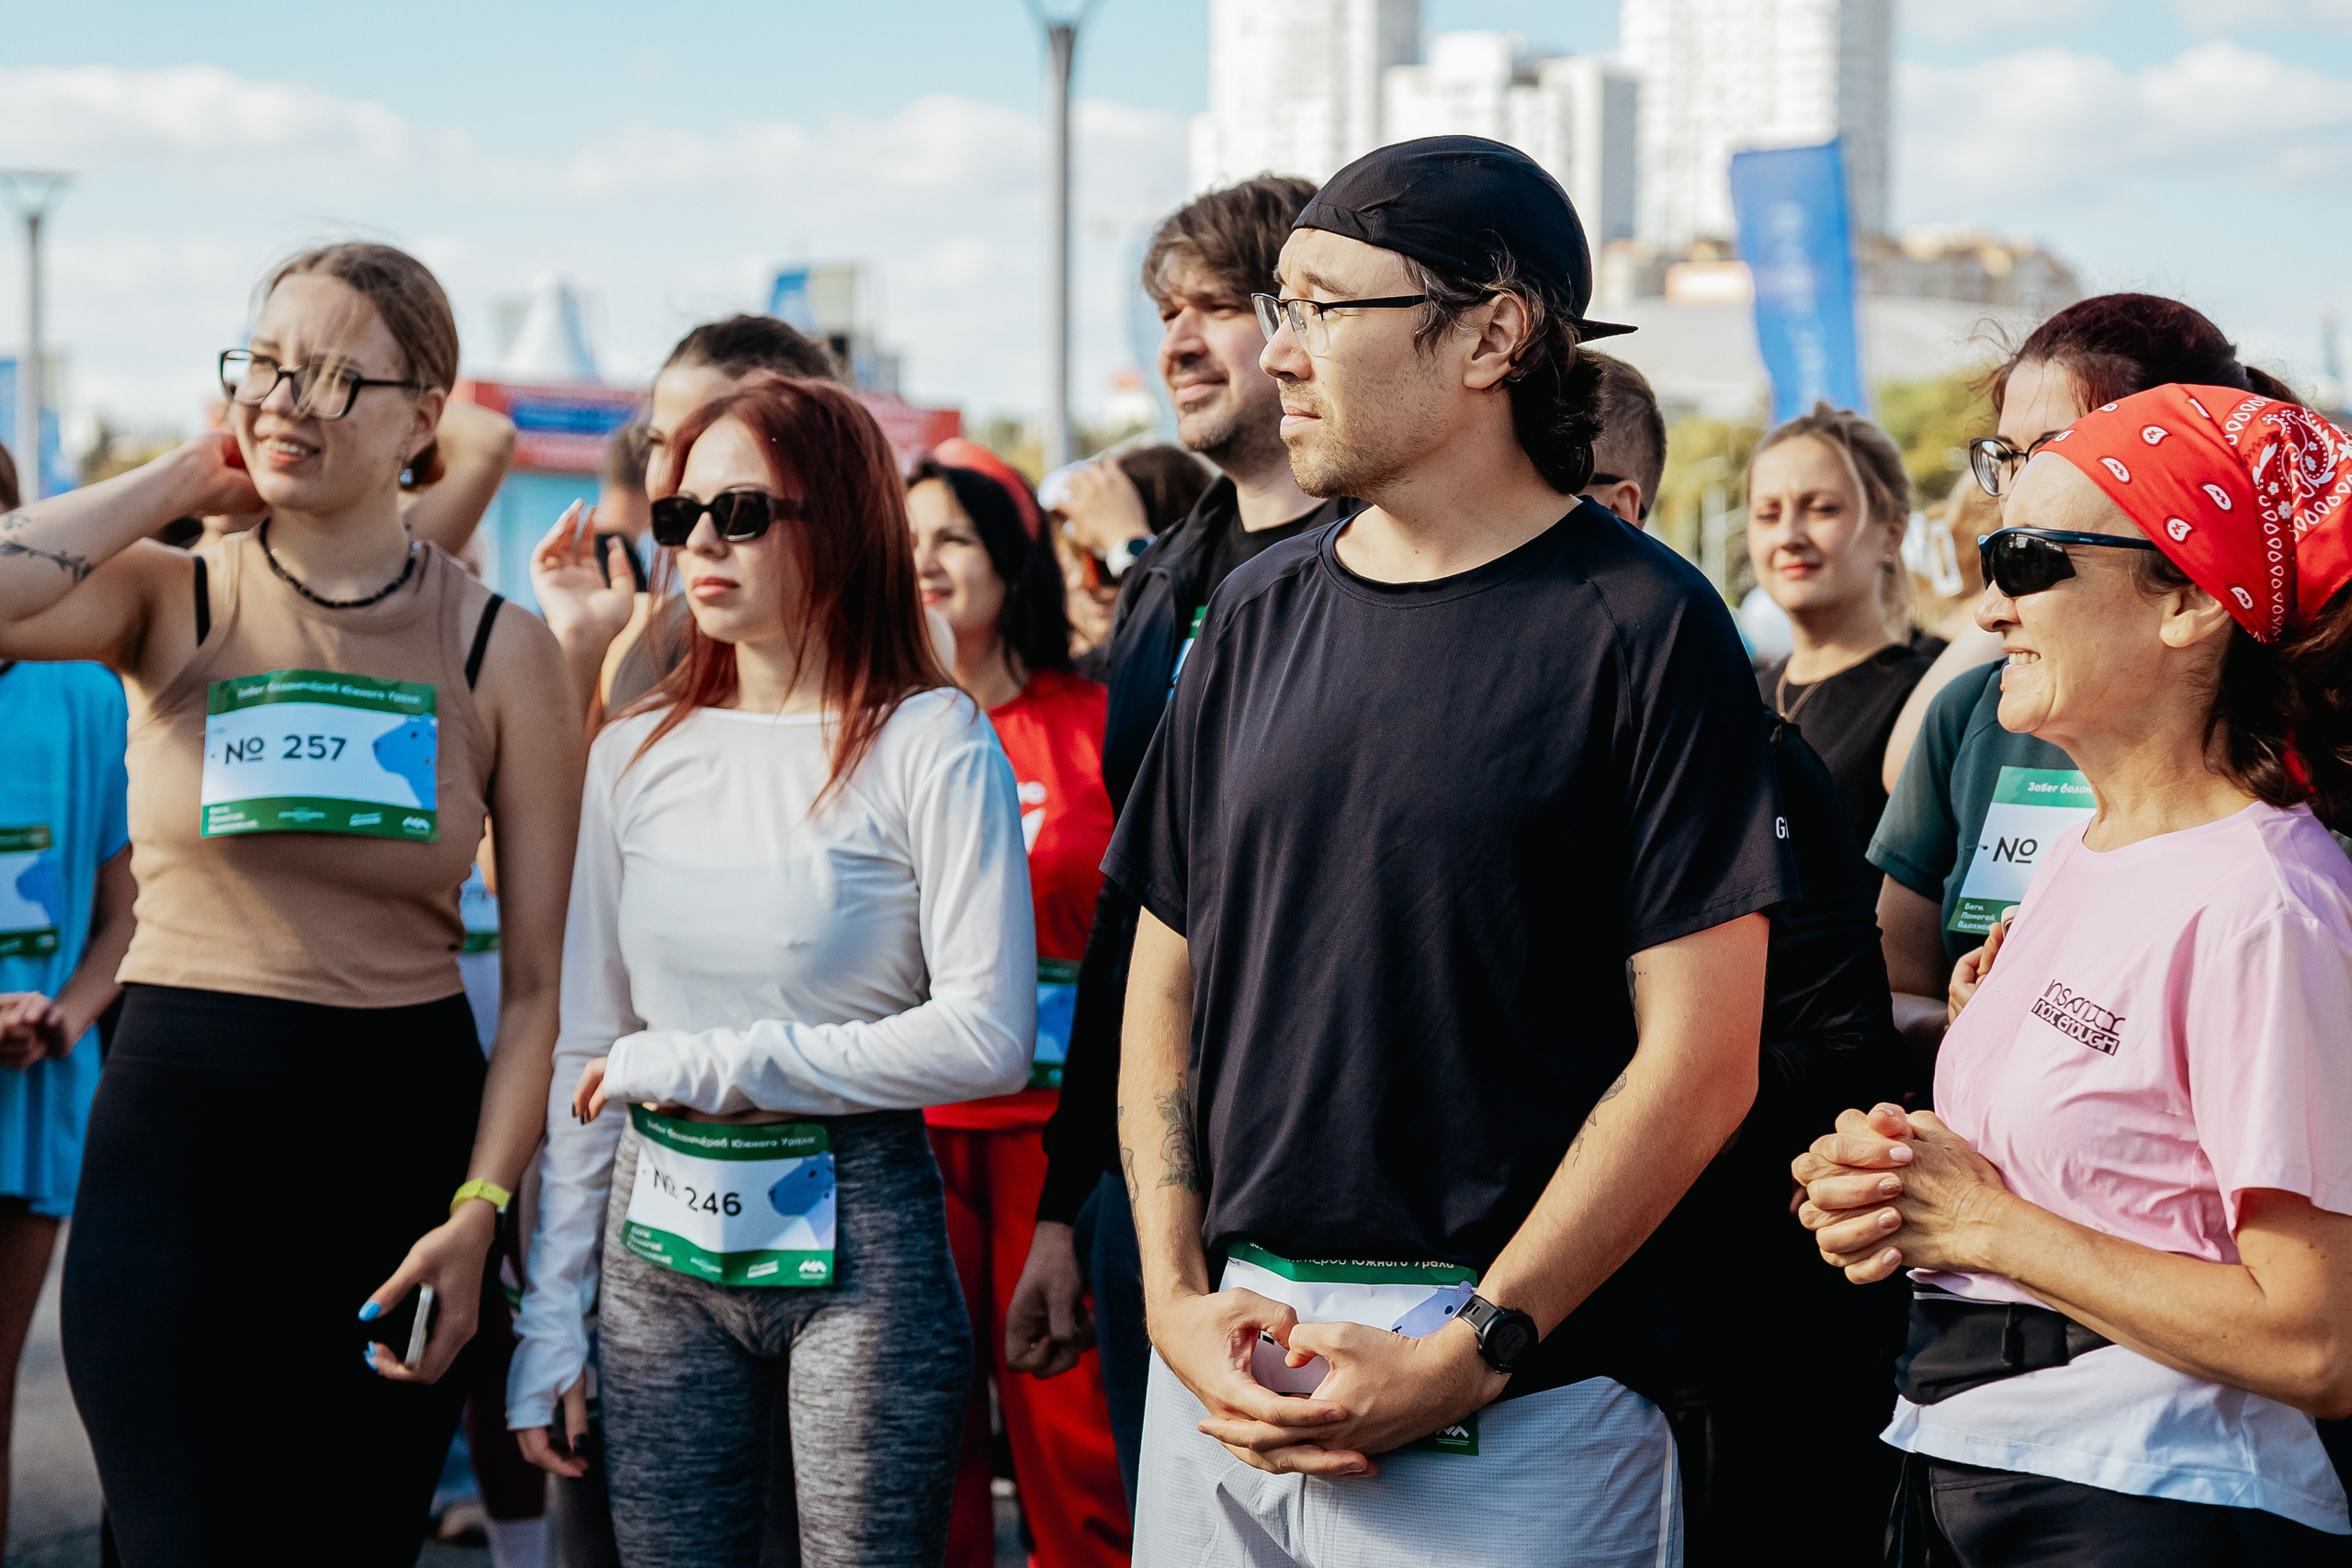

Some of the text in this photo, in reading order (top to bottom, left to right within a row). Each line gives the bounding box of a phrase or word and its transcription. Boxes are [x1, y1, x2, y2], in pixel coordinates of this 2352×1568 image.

[282, 734, 346, 762] 257
[2027, 781, 2058, 793] Забег
[1775, 816, 1790, 839] G
[730, 1139, 777, 1148] Южного
[781, 1136, 815, 1147] Урала
[684, 1186, 742, 1217] 246
